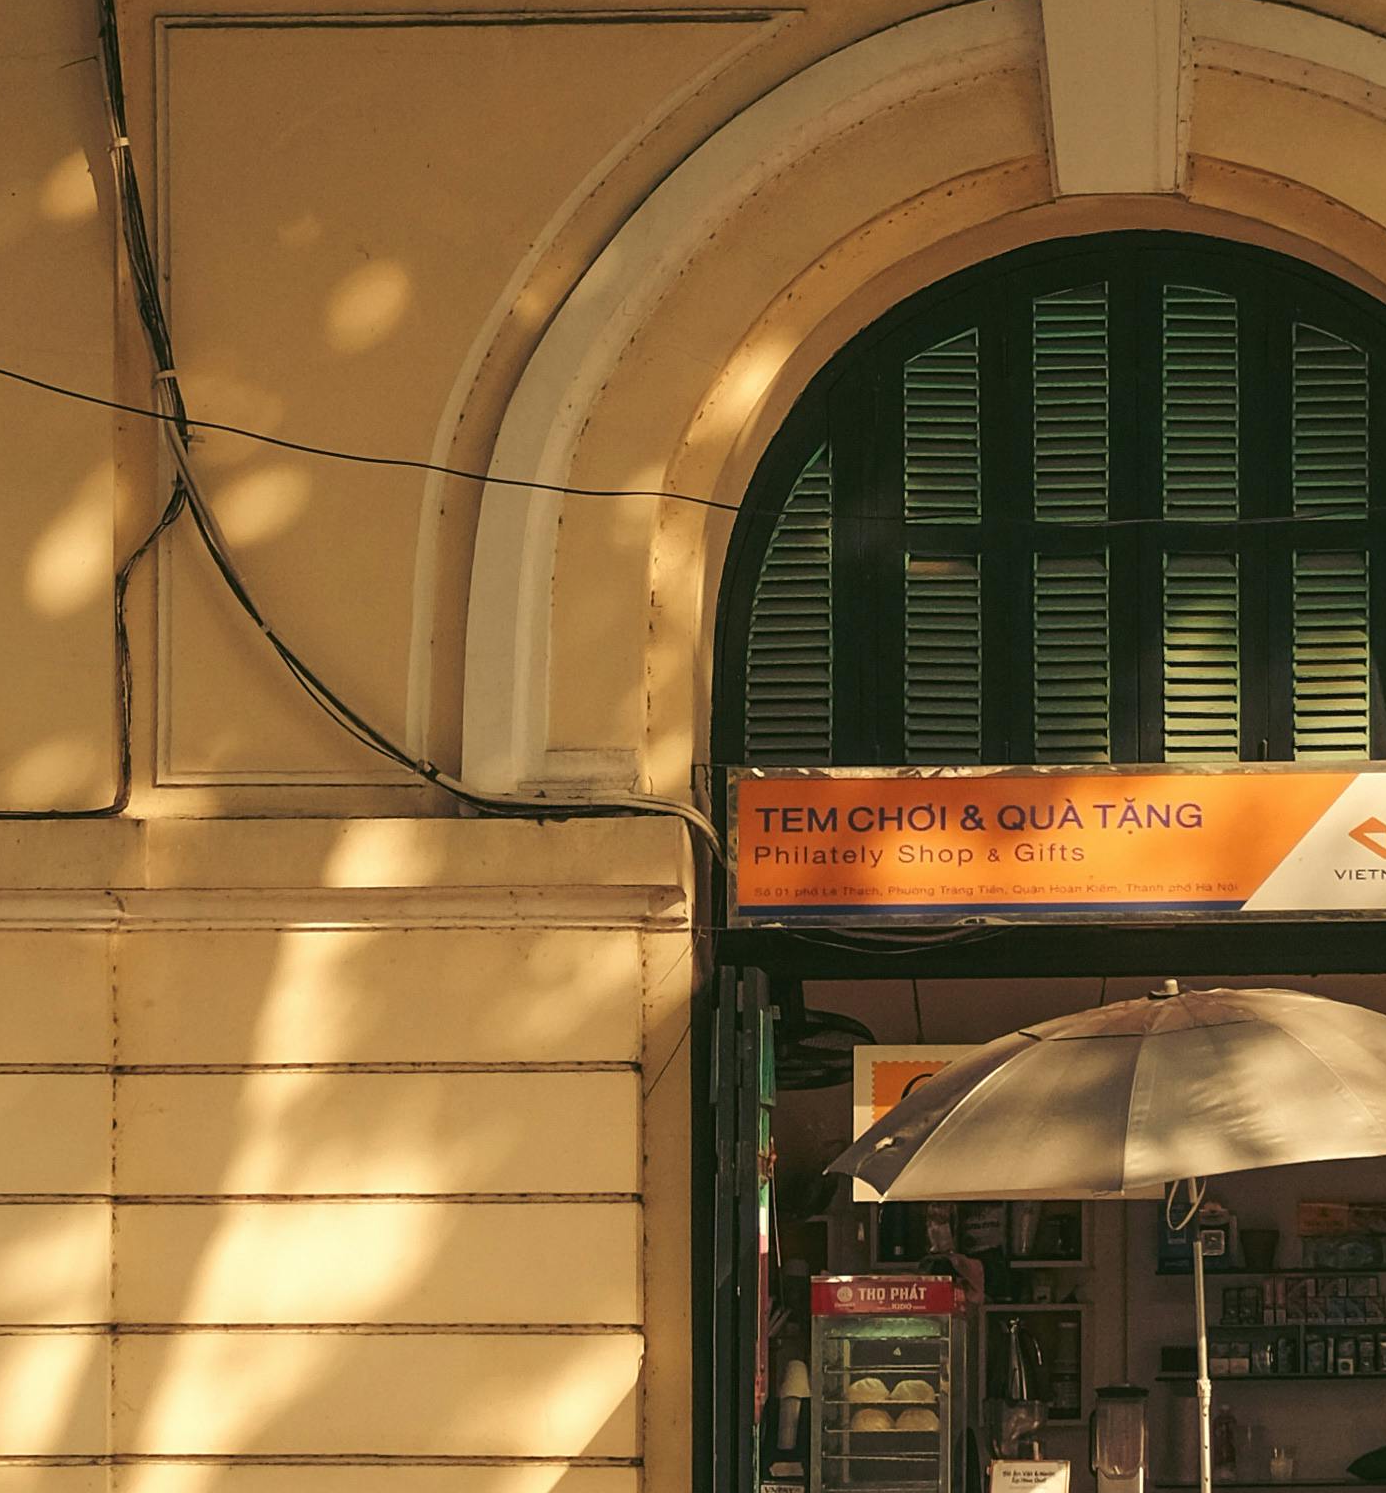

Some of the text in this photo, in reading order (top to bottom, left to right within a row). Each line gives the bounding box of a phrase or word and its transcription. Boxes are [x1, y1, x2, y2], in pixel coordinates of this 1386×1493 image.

[755, 796, 1203, 835] TEM CHƠI & QUÀ TẶNG
[754, 843, 1085, 868] Philately Shop & Gifts
[858, 1283, 927, 1304] THỌ PHÁT
